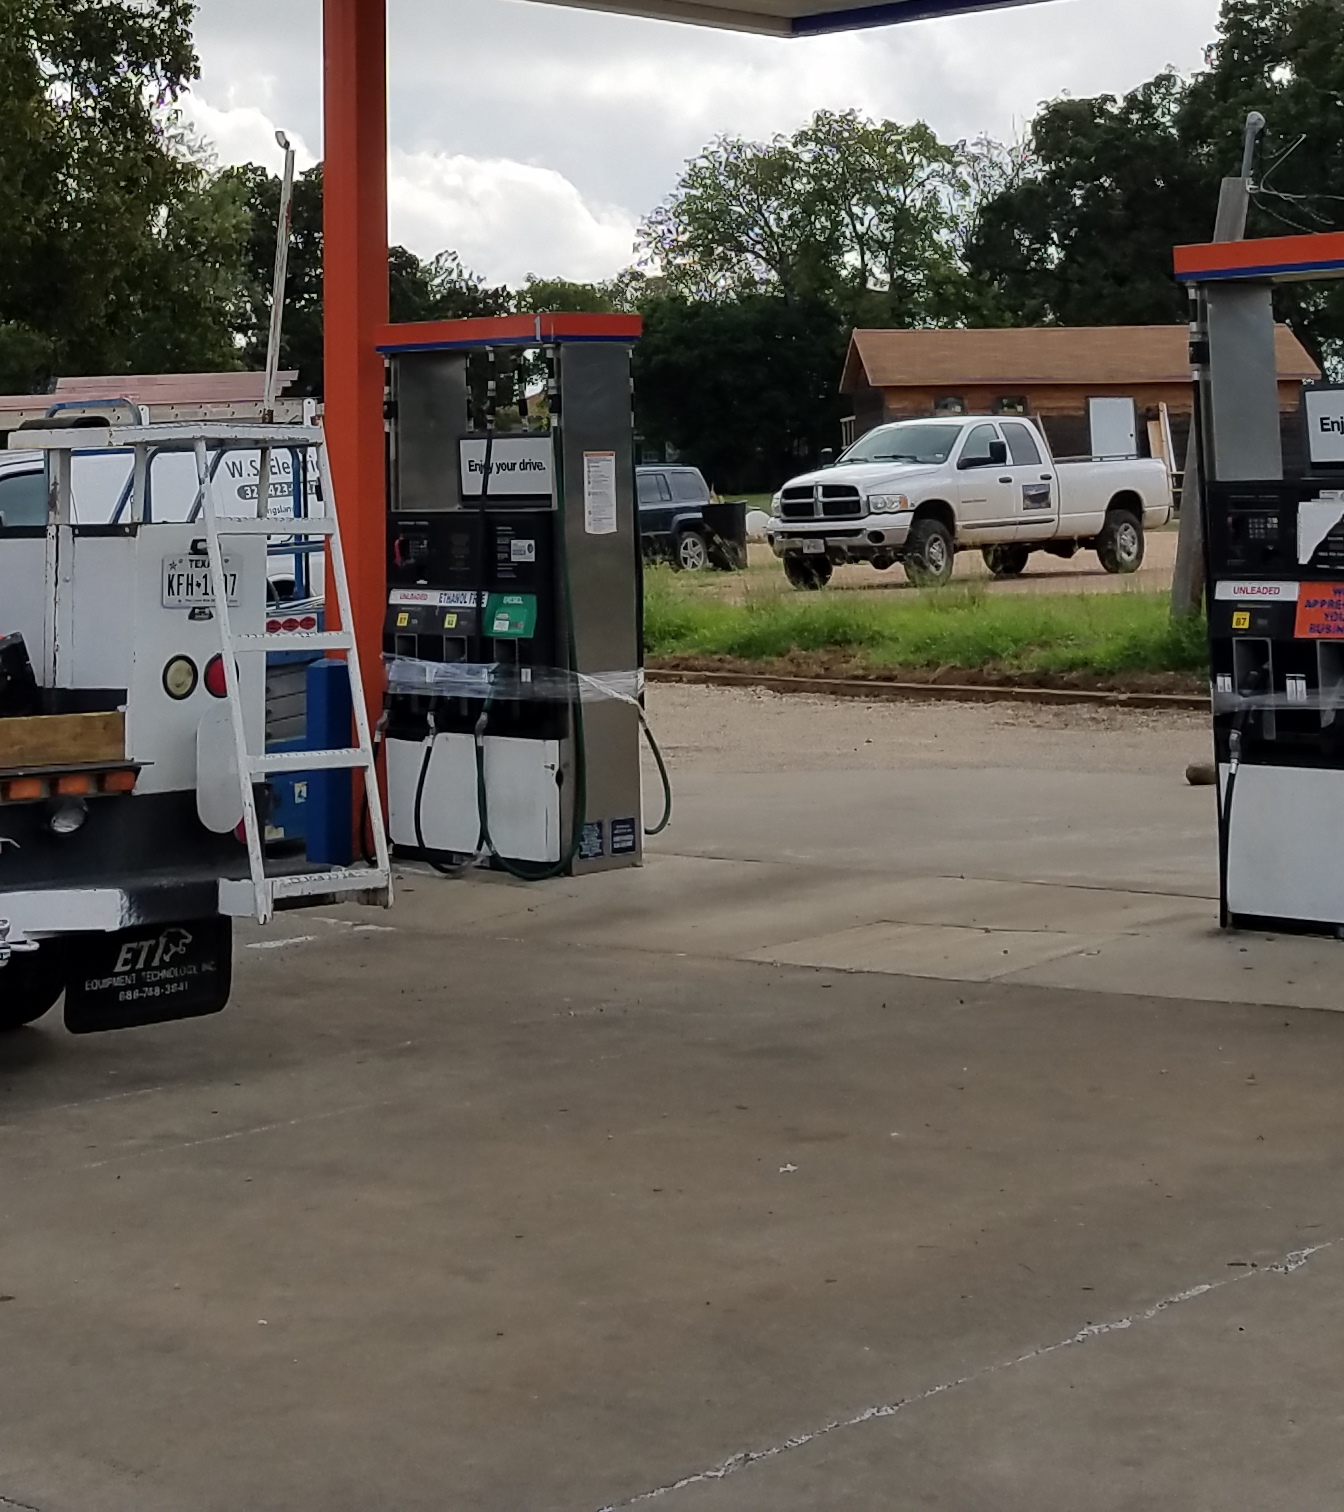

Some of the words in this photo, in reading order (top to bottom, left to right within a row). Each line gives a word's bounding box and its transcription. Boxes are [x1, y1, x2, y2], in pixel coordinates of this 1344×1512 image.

[535, 316, 541, 341] 1
[495, 461, 517, 475] your
[519, 459, 546, 472] drive.
[167, 573, 194, 596] KFH
[1233, 586, 1281, 596] UNLEADED
[113, 939, 168, 973] ETI
